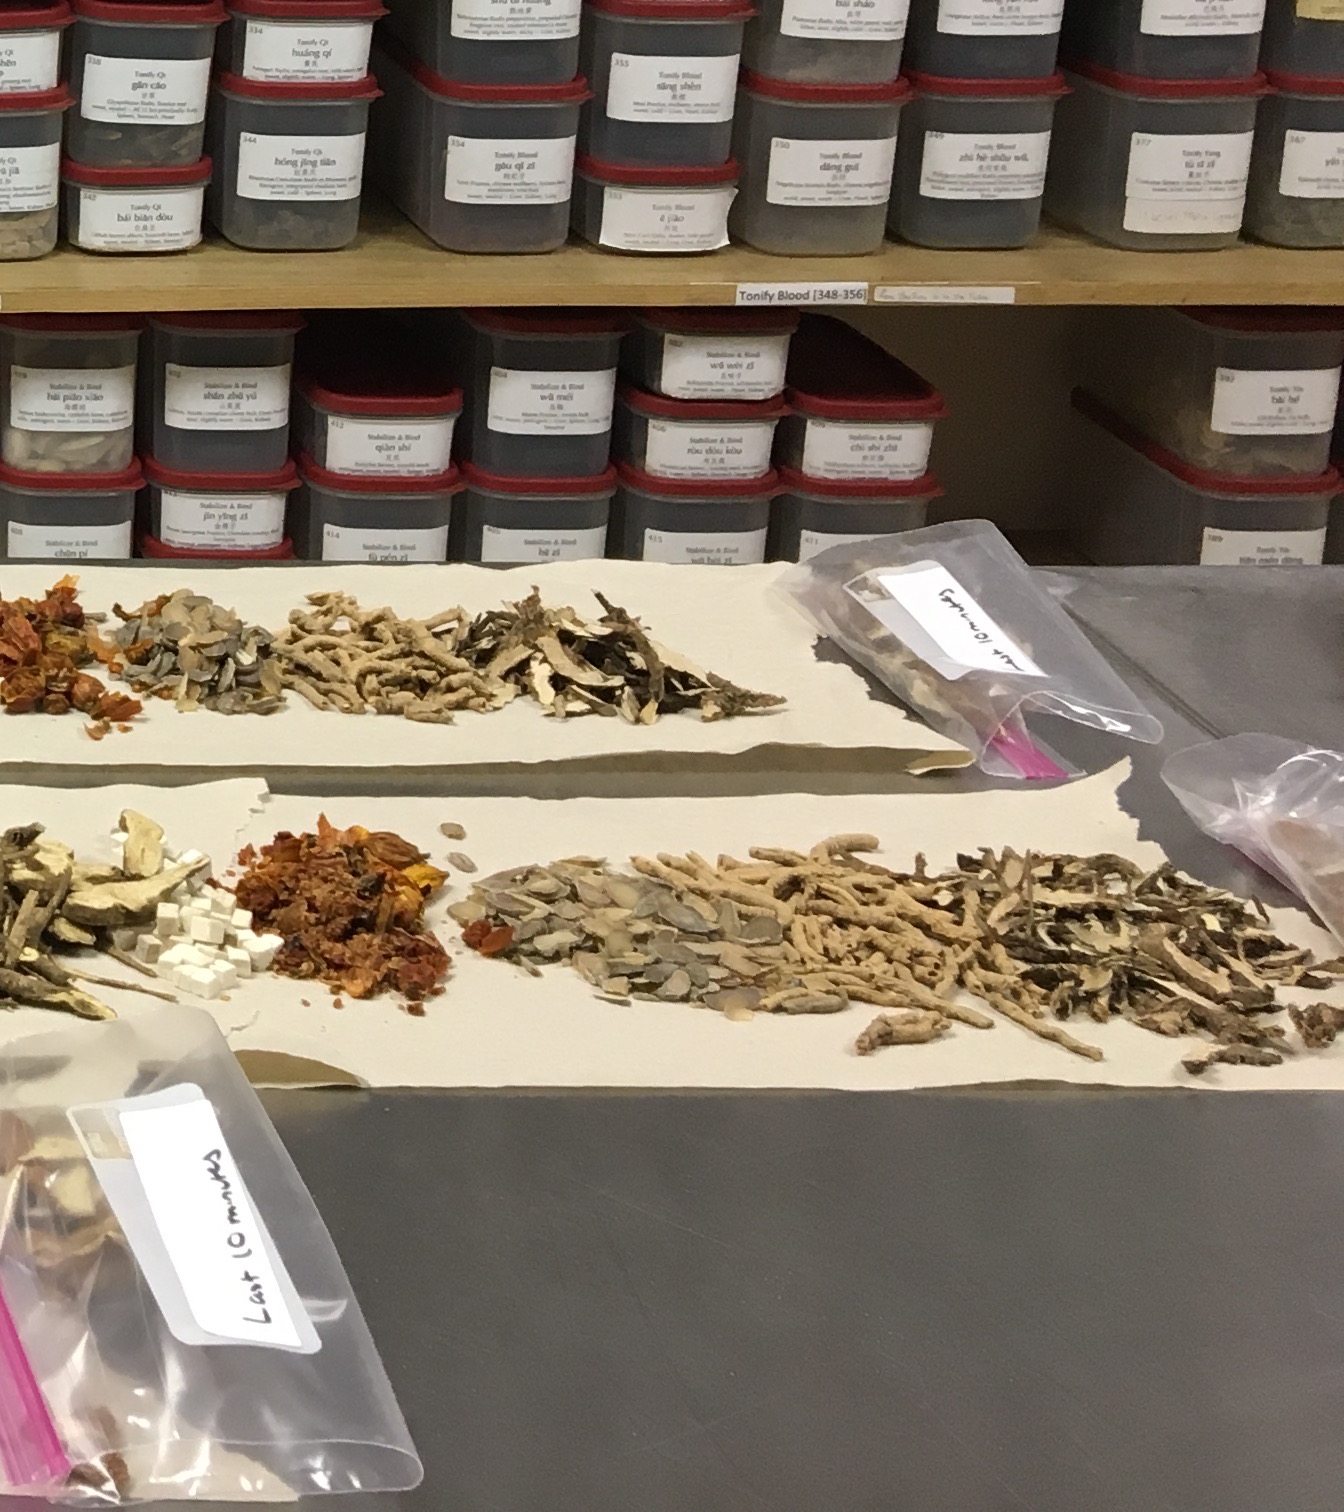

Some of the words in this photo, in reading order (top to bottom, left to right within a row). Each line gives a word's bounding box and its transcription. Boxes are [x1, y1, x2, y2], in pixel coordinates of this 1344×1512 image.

[739, 290, 775, 303] Tonify
[778, 290, 810, 301] Blood
[813, 289, 868, 303] [348-356]
[203, 1148, 240, 1223] minutes
[225, 1230, 253, 1263] 10
[240, 1269, 273, 1326] Last
